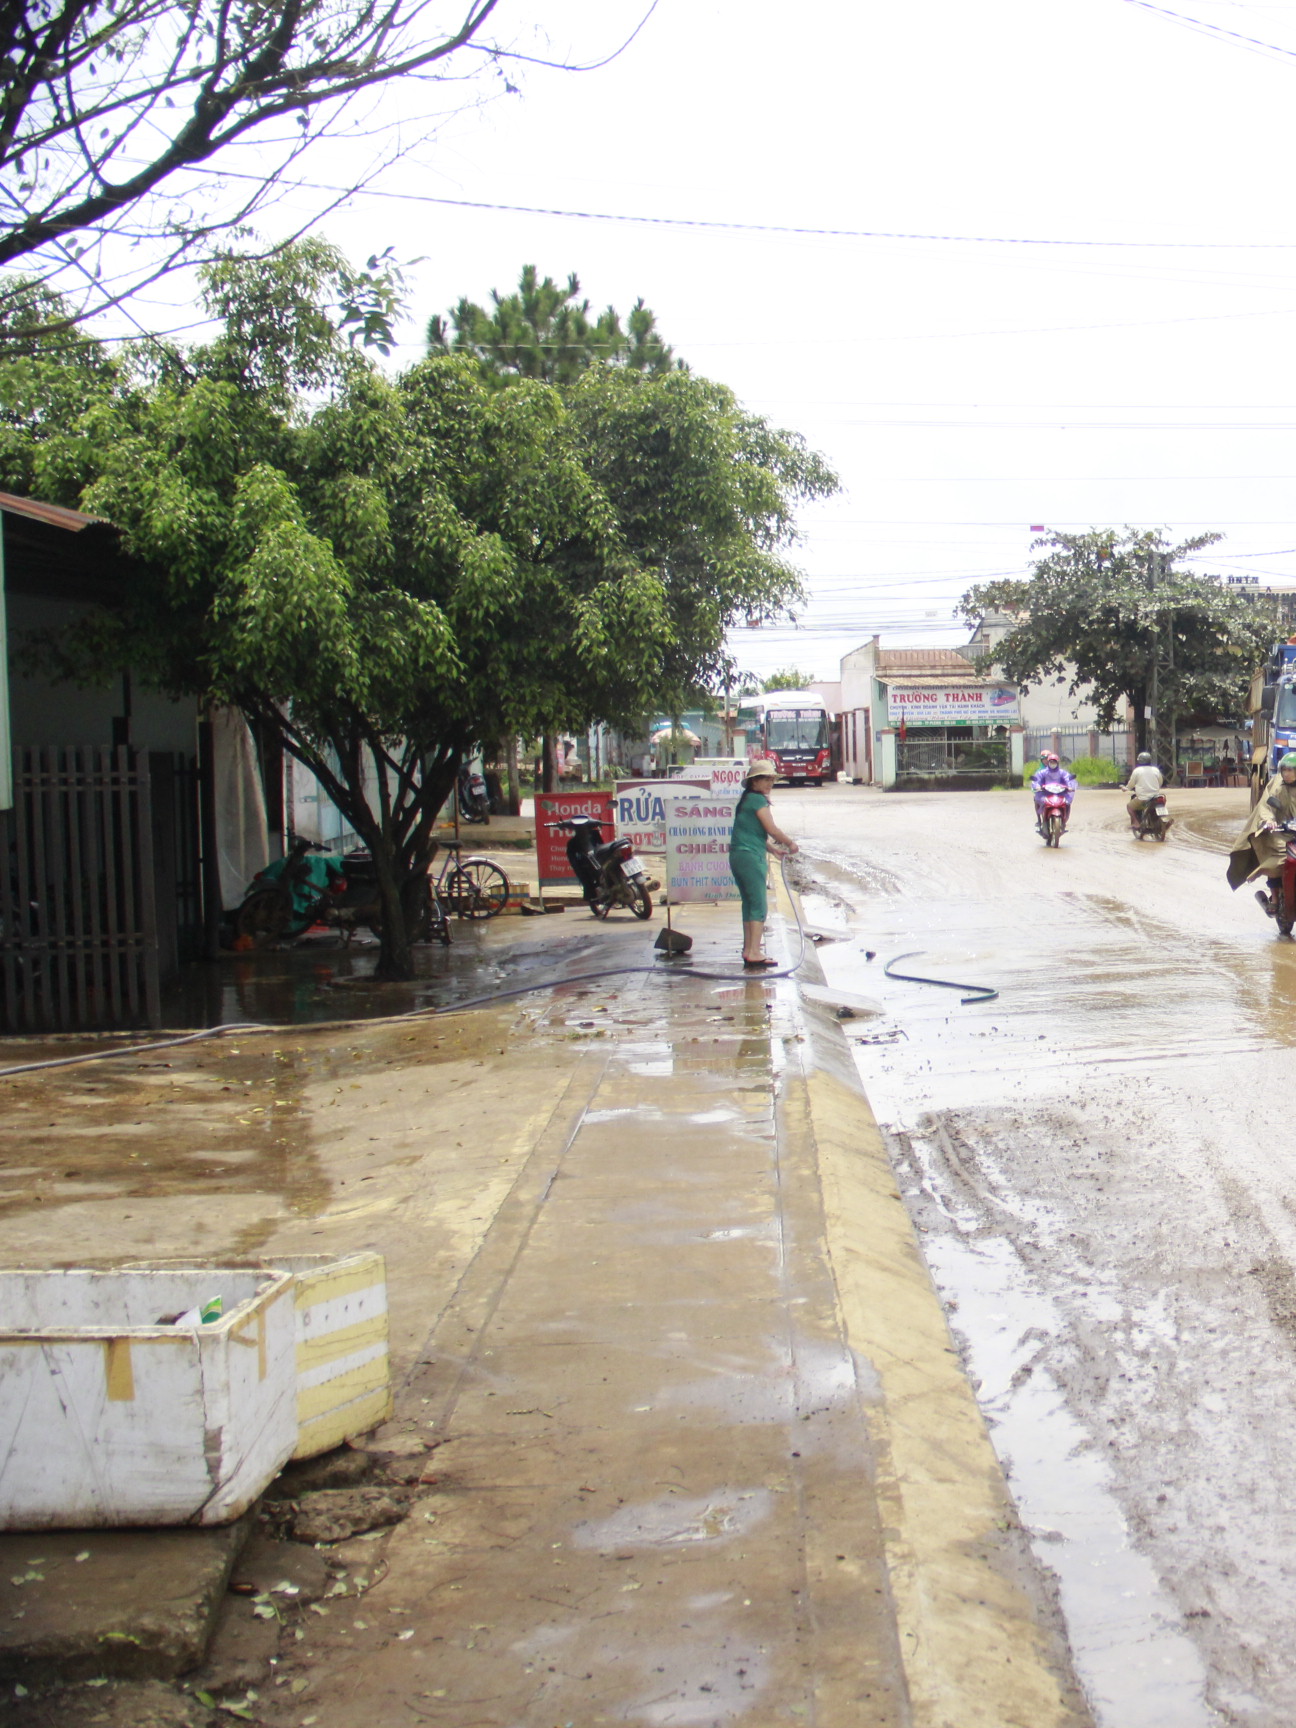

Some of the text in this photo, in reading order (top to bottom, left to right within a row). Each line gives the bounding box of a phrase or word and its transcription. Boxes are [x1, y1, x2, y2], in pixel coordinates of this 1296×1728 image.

[891, 690, 983, 703] TRƯỜNG THÀNH
[712, 770, 740, 786] NGỌC
[620, 787, 666, 822] RỬA
[674, 803, 732, 818] SÁNG
[669, 824, 687, 836] CHÁO
